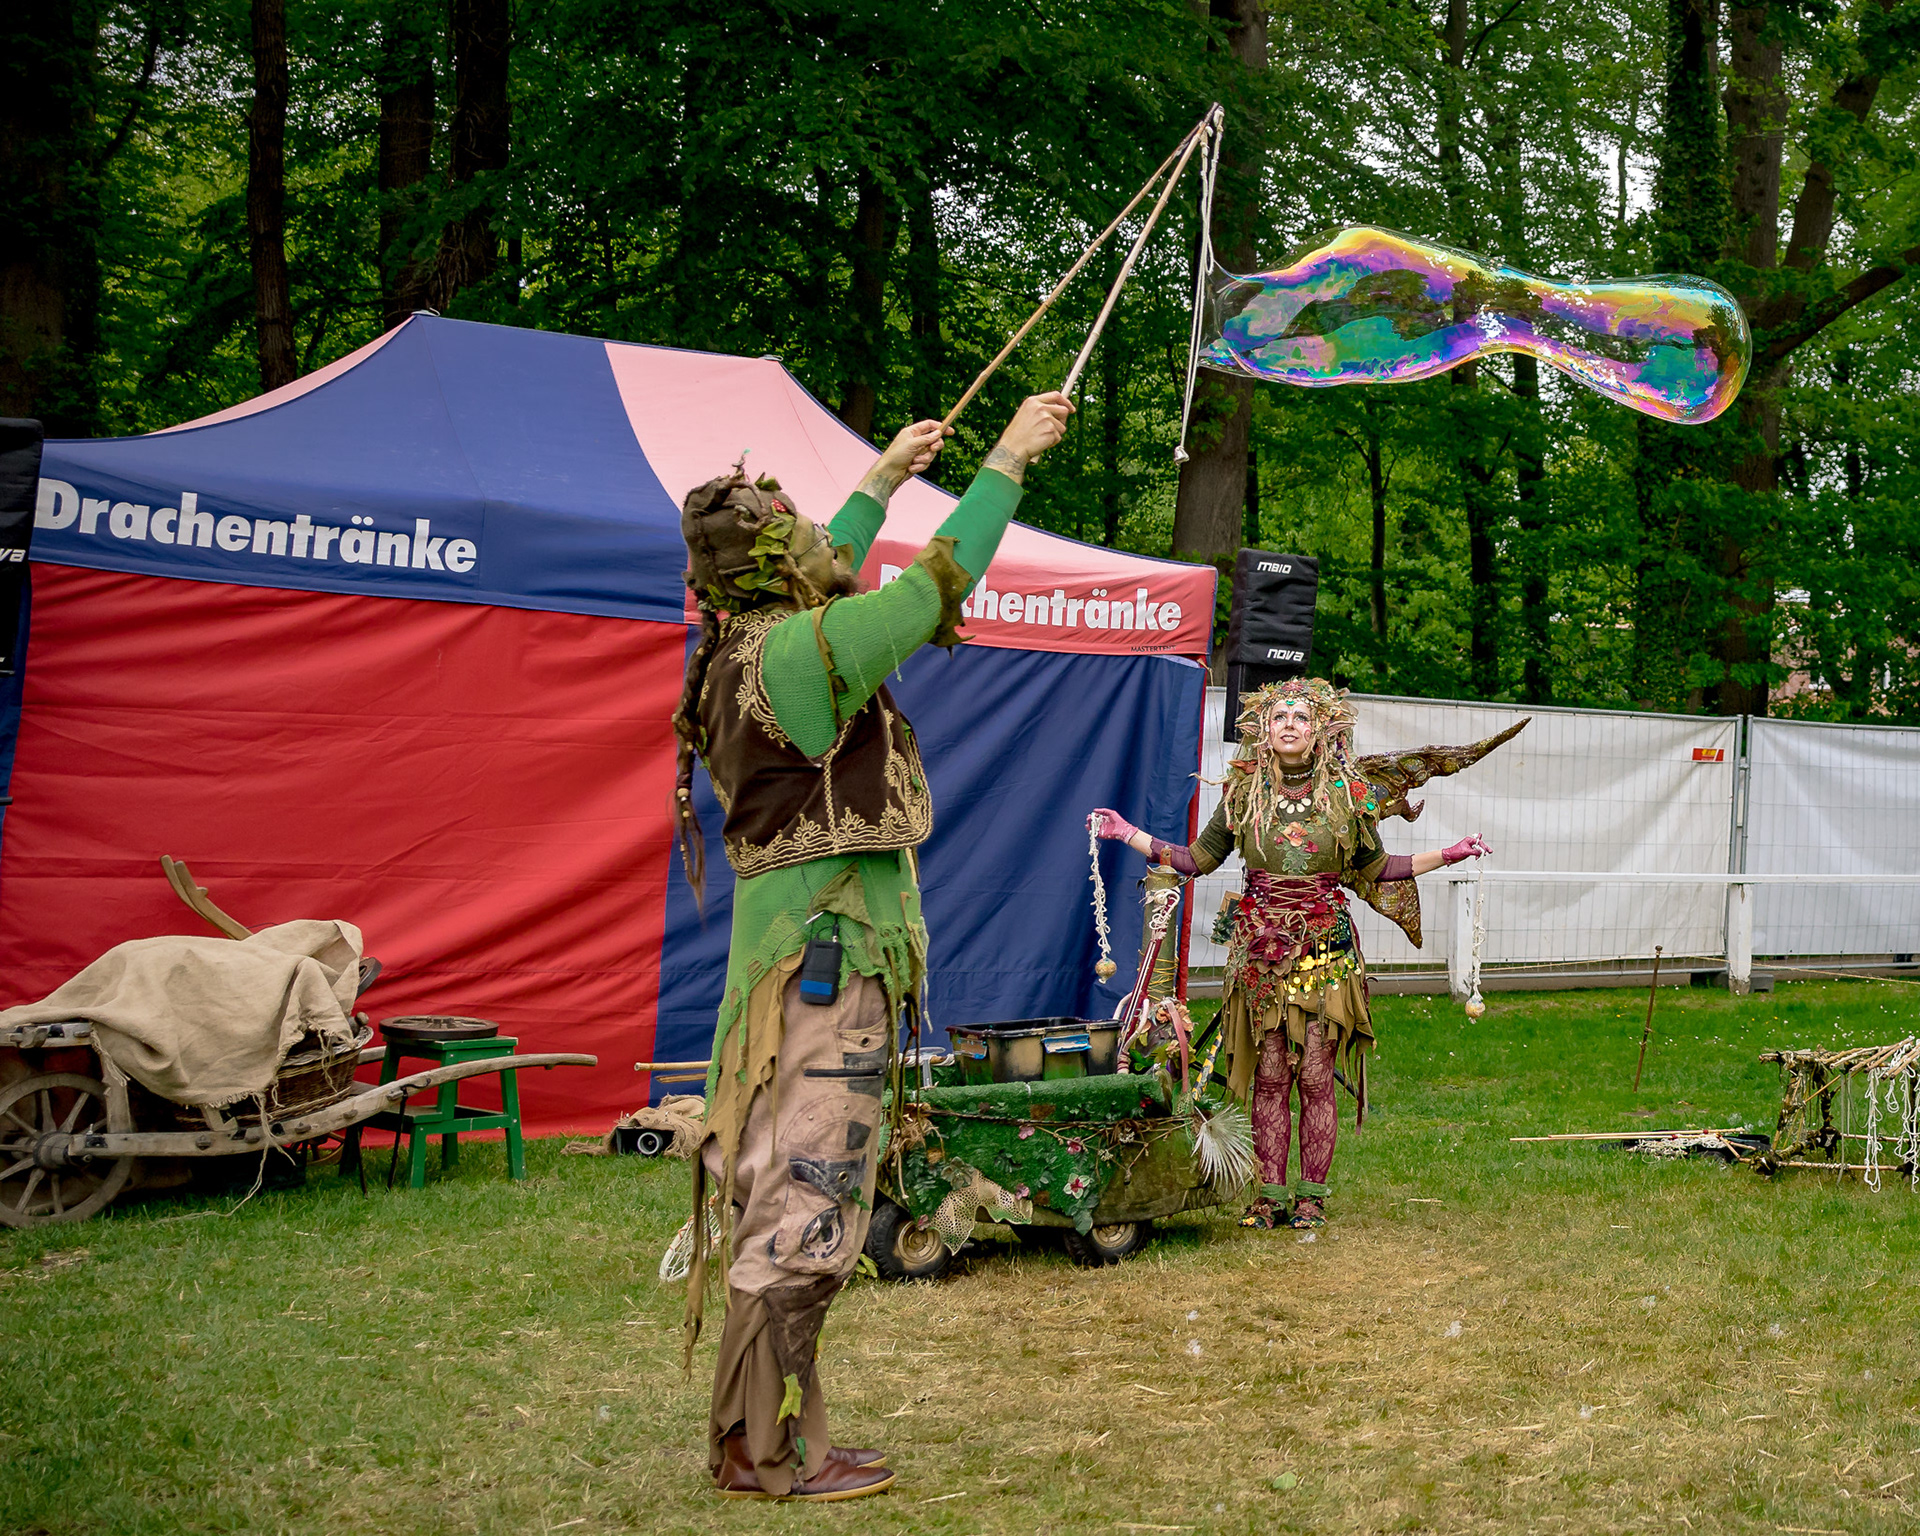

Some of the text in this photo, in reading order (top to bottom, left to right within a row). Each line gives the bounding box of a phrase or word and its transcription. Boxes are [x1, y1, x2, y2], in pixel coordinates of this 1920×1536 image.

[33, 477, 477, 574] Drachentränke
[880, 563, 1183, 631] hentränke
[1266, 648, 1305, 662] nova
